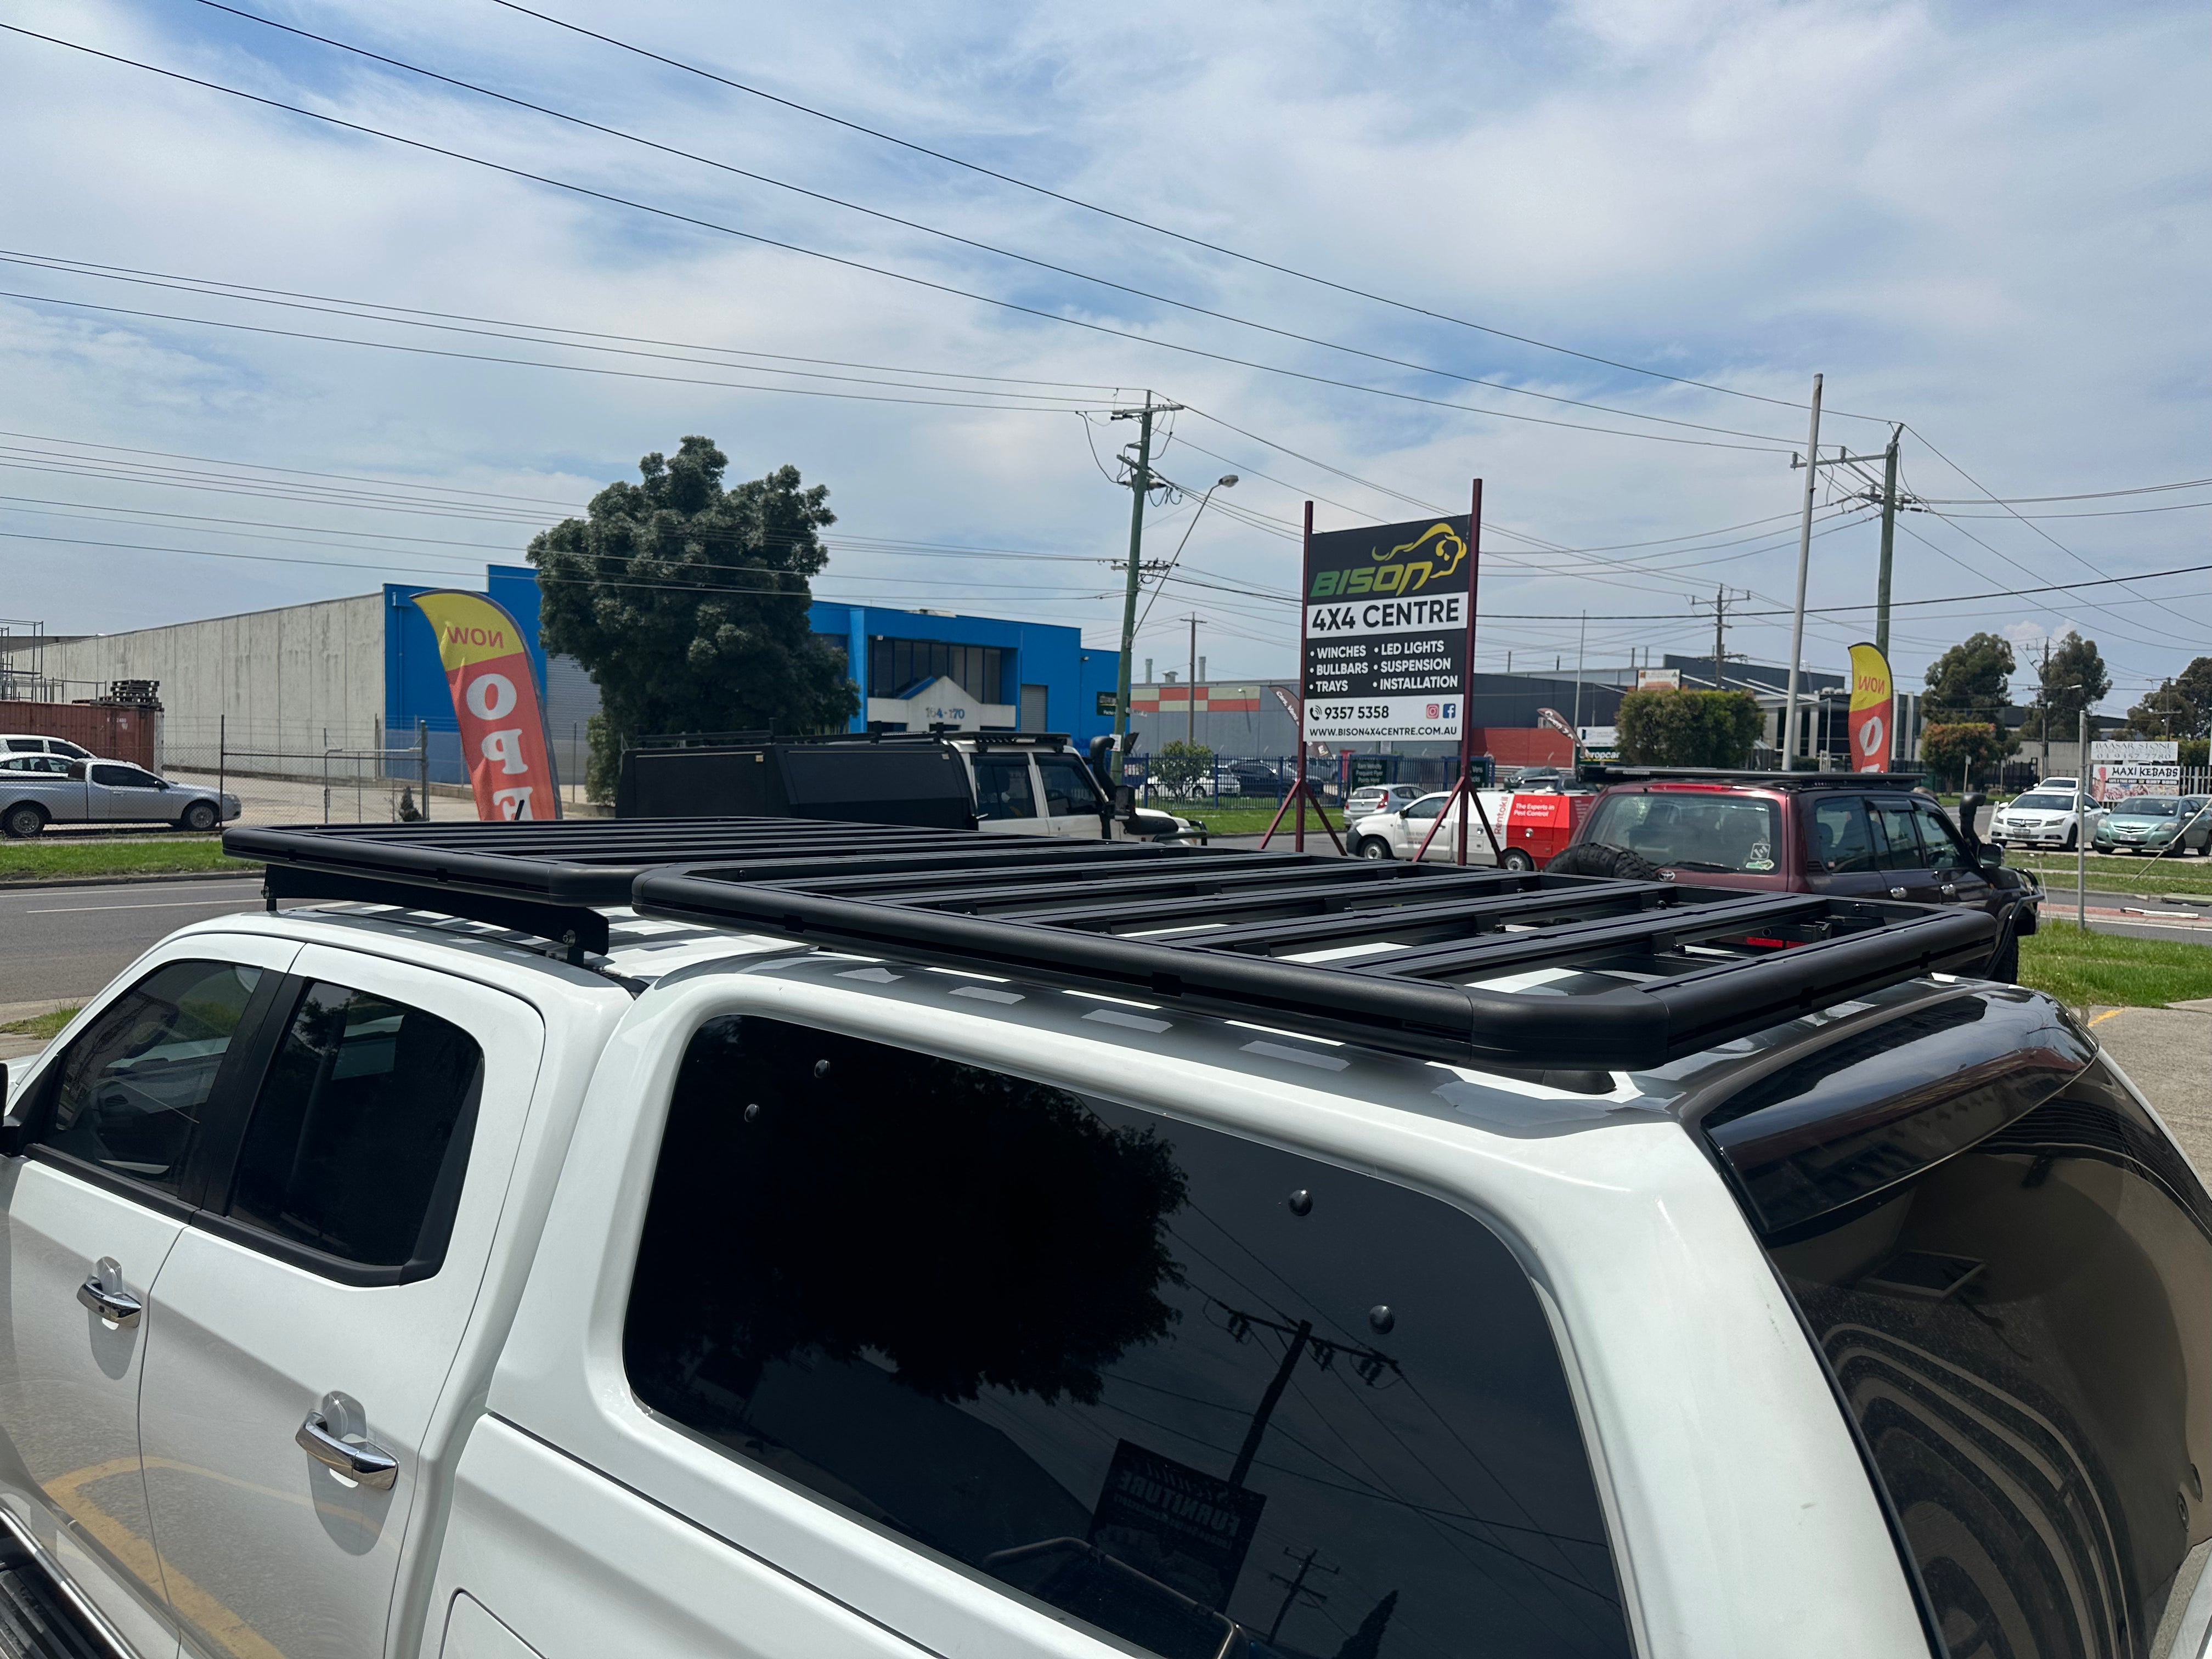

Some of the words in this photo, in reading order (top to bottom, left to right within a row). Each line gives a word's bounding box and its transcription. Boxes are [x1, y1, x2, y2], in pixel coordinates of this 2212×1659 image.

[1310, 561, 1433, 596] BISON
[1312, 607, 1356, 631] 4X4
[1363, 598, 1459, 628] CENTRE
[1317, 645, 1367, 658] WINCHES
[1381, 642, 1402, 656] LED
[1404, 640, 1444, 654] LIGHTS
[1316, 662, 1369, 675] BULLBARS
[1380, 658, 1451, 673] SUSPENSION
[1316, 680, 1348, 692] TRAYS
[1380, 675, 1458, 690] INSTALLATION
[1324, 707, 1354, 720] 9357
[1358, 705, 1389, 719] 5358
[1310, 726, 1457, 737] WWW.BISON4X4CENTRE.COM.AU
[2112, 767, 2136, 776] MAXI
[2140, 767, 2178, 777] KEBABS
